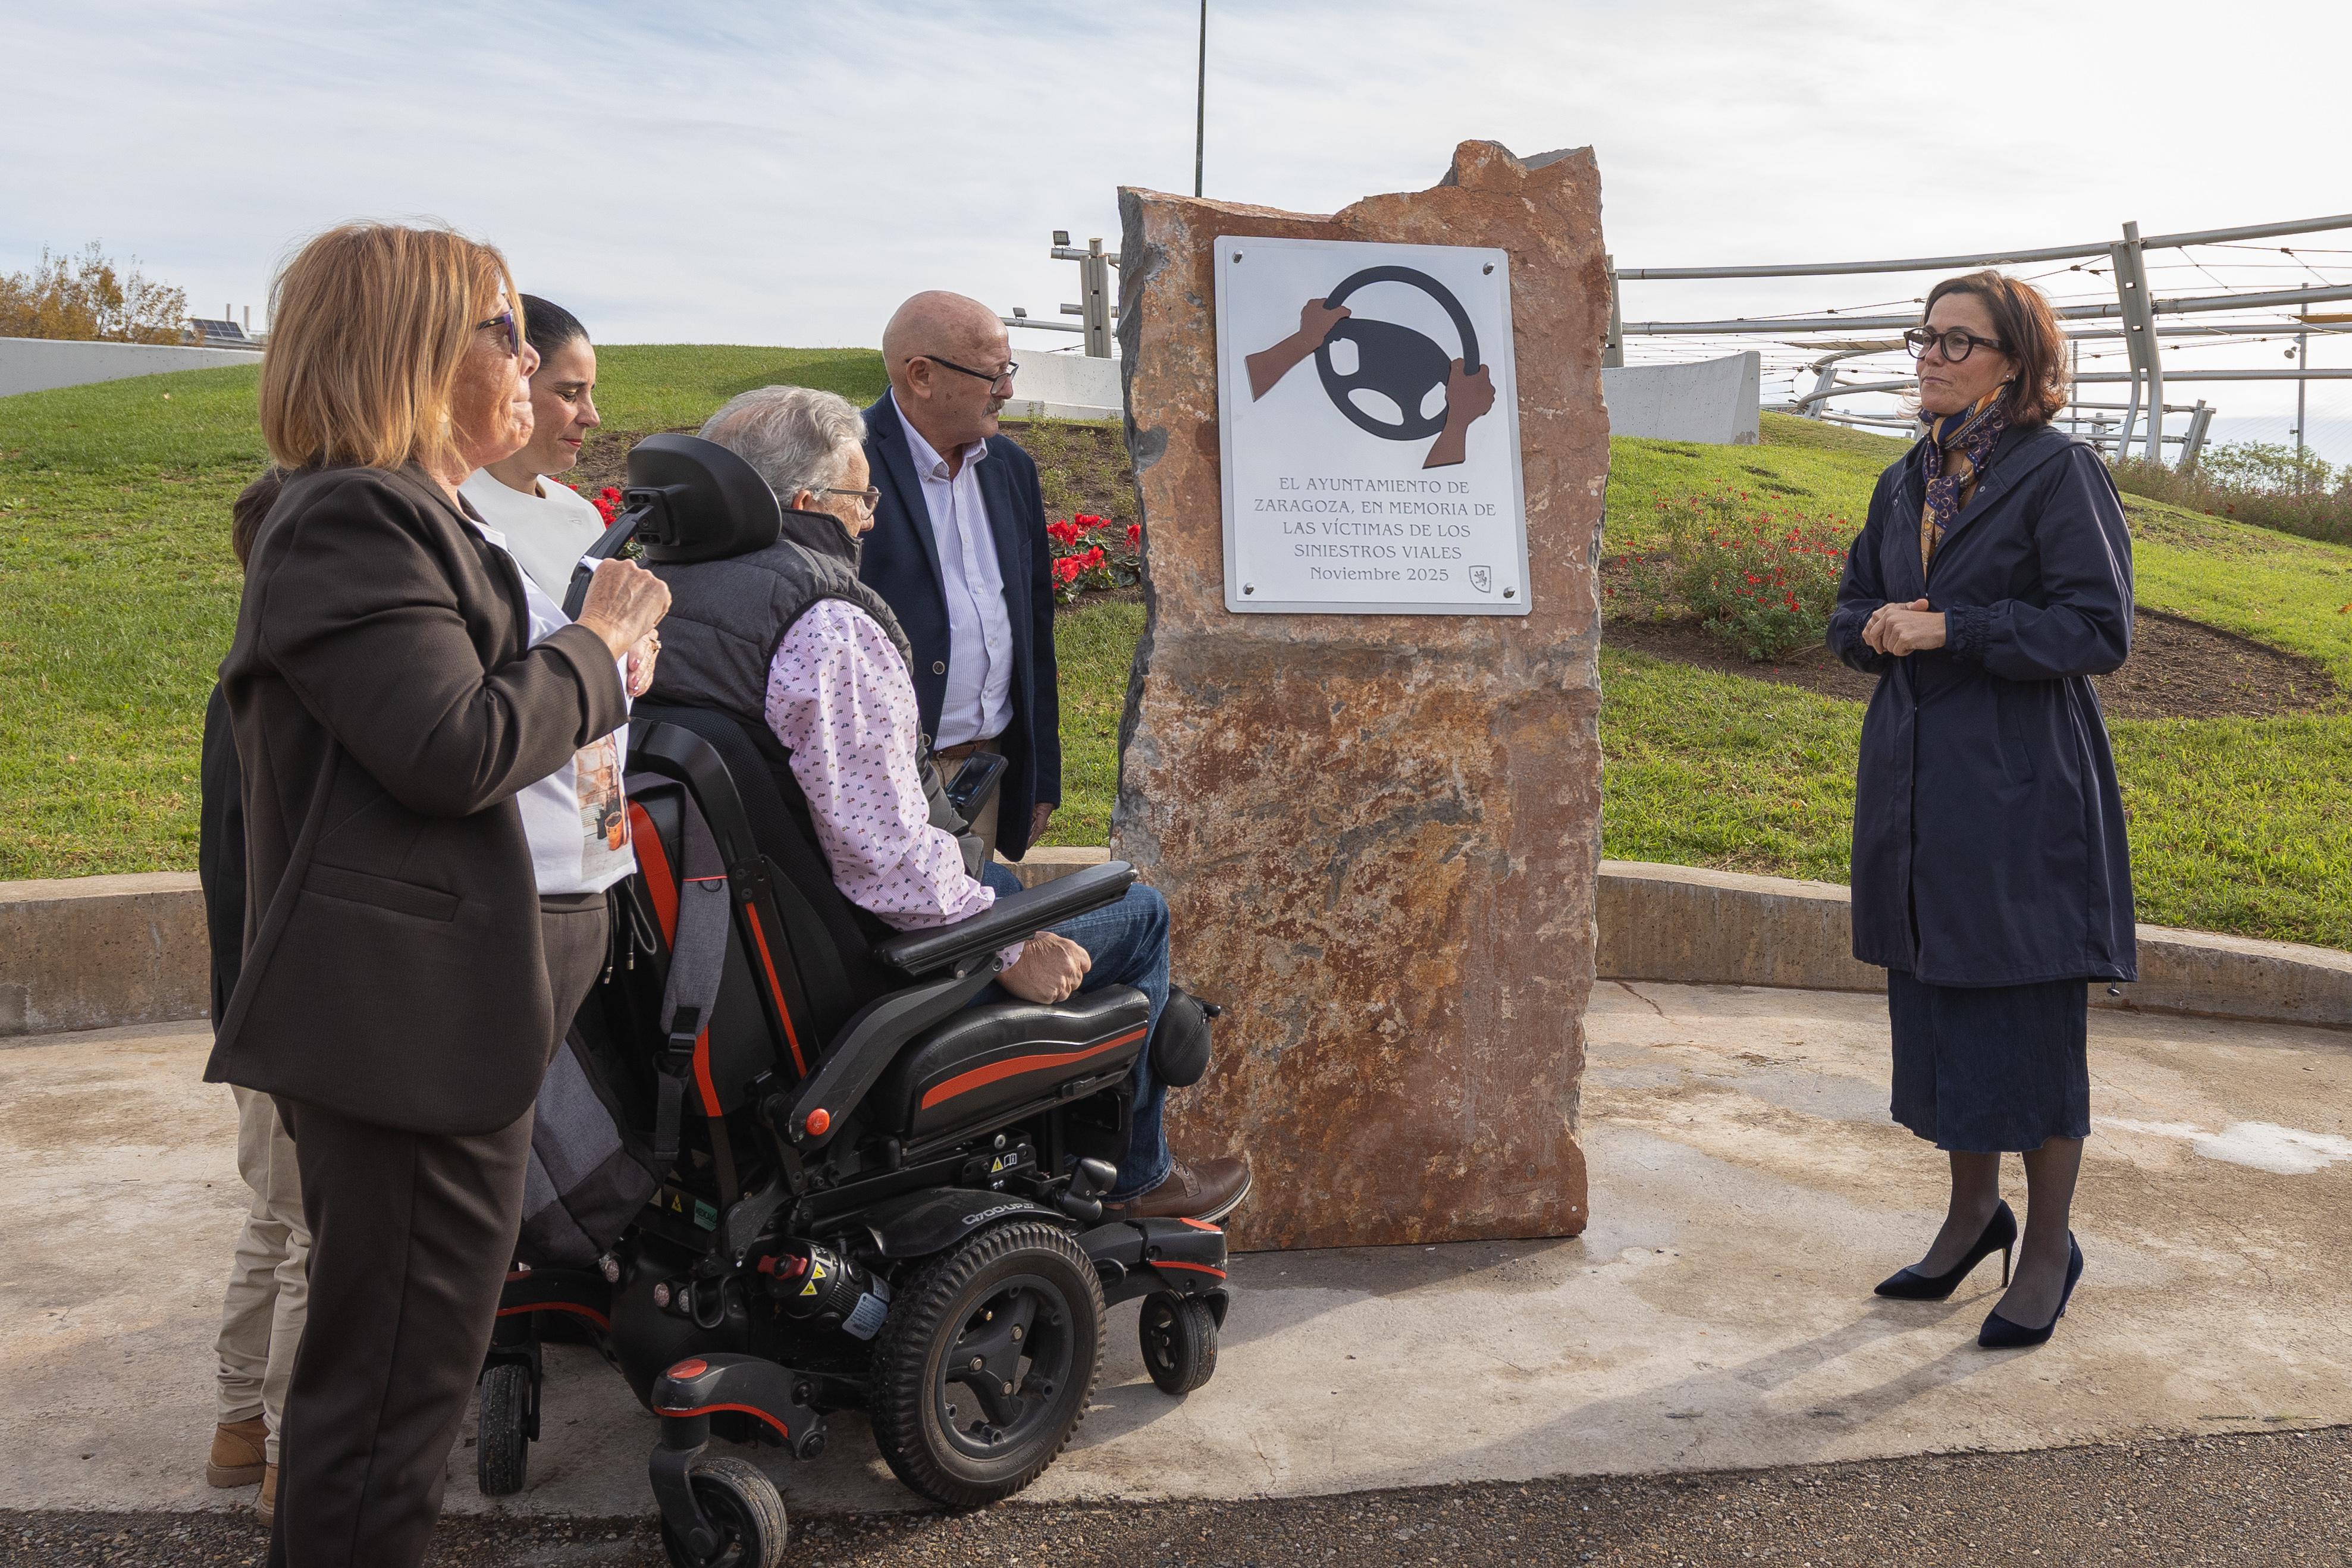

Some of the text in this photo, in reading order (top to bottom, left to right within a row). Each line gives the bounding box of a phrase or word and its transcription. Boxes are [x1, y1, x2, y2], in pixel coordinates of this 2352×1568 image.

[1280, 477, 1470, 494] EL AYUNTAMIENTO DE
[1254, 498, 1496, 516] ZARAGOZA, EN MEMORIA DE
[1283, 518, 1470, 538] LAS VÍCTIMAS DE LOS
[1294, 544, 1462, 559] SINIESTROS VIALES
[1310, 566, 1449, 581] Noviembre 2025
